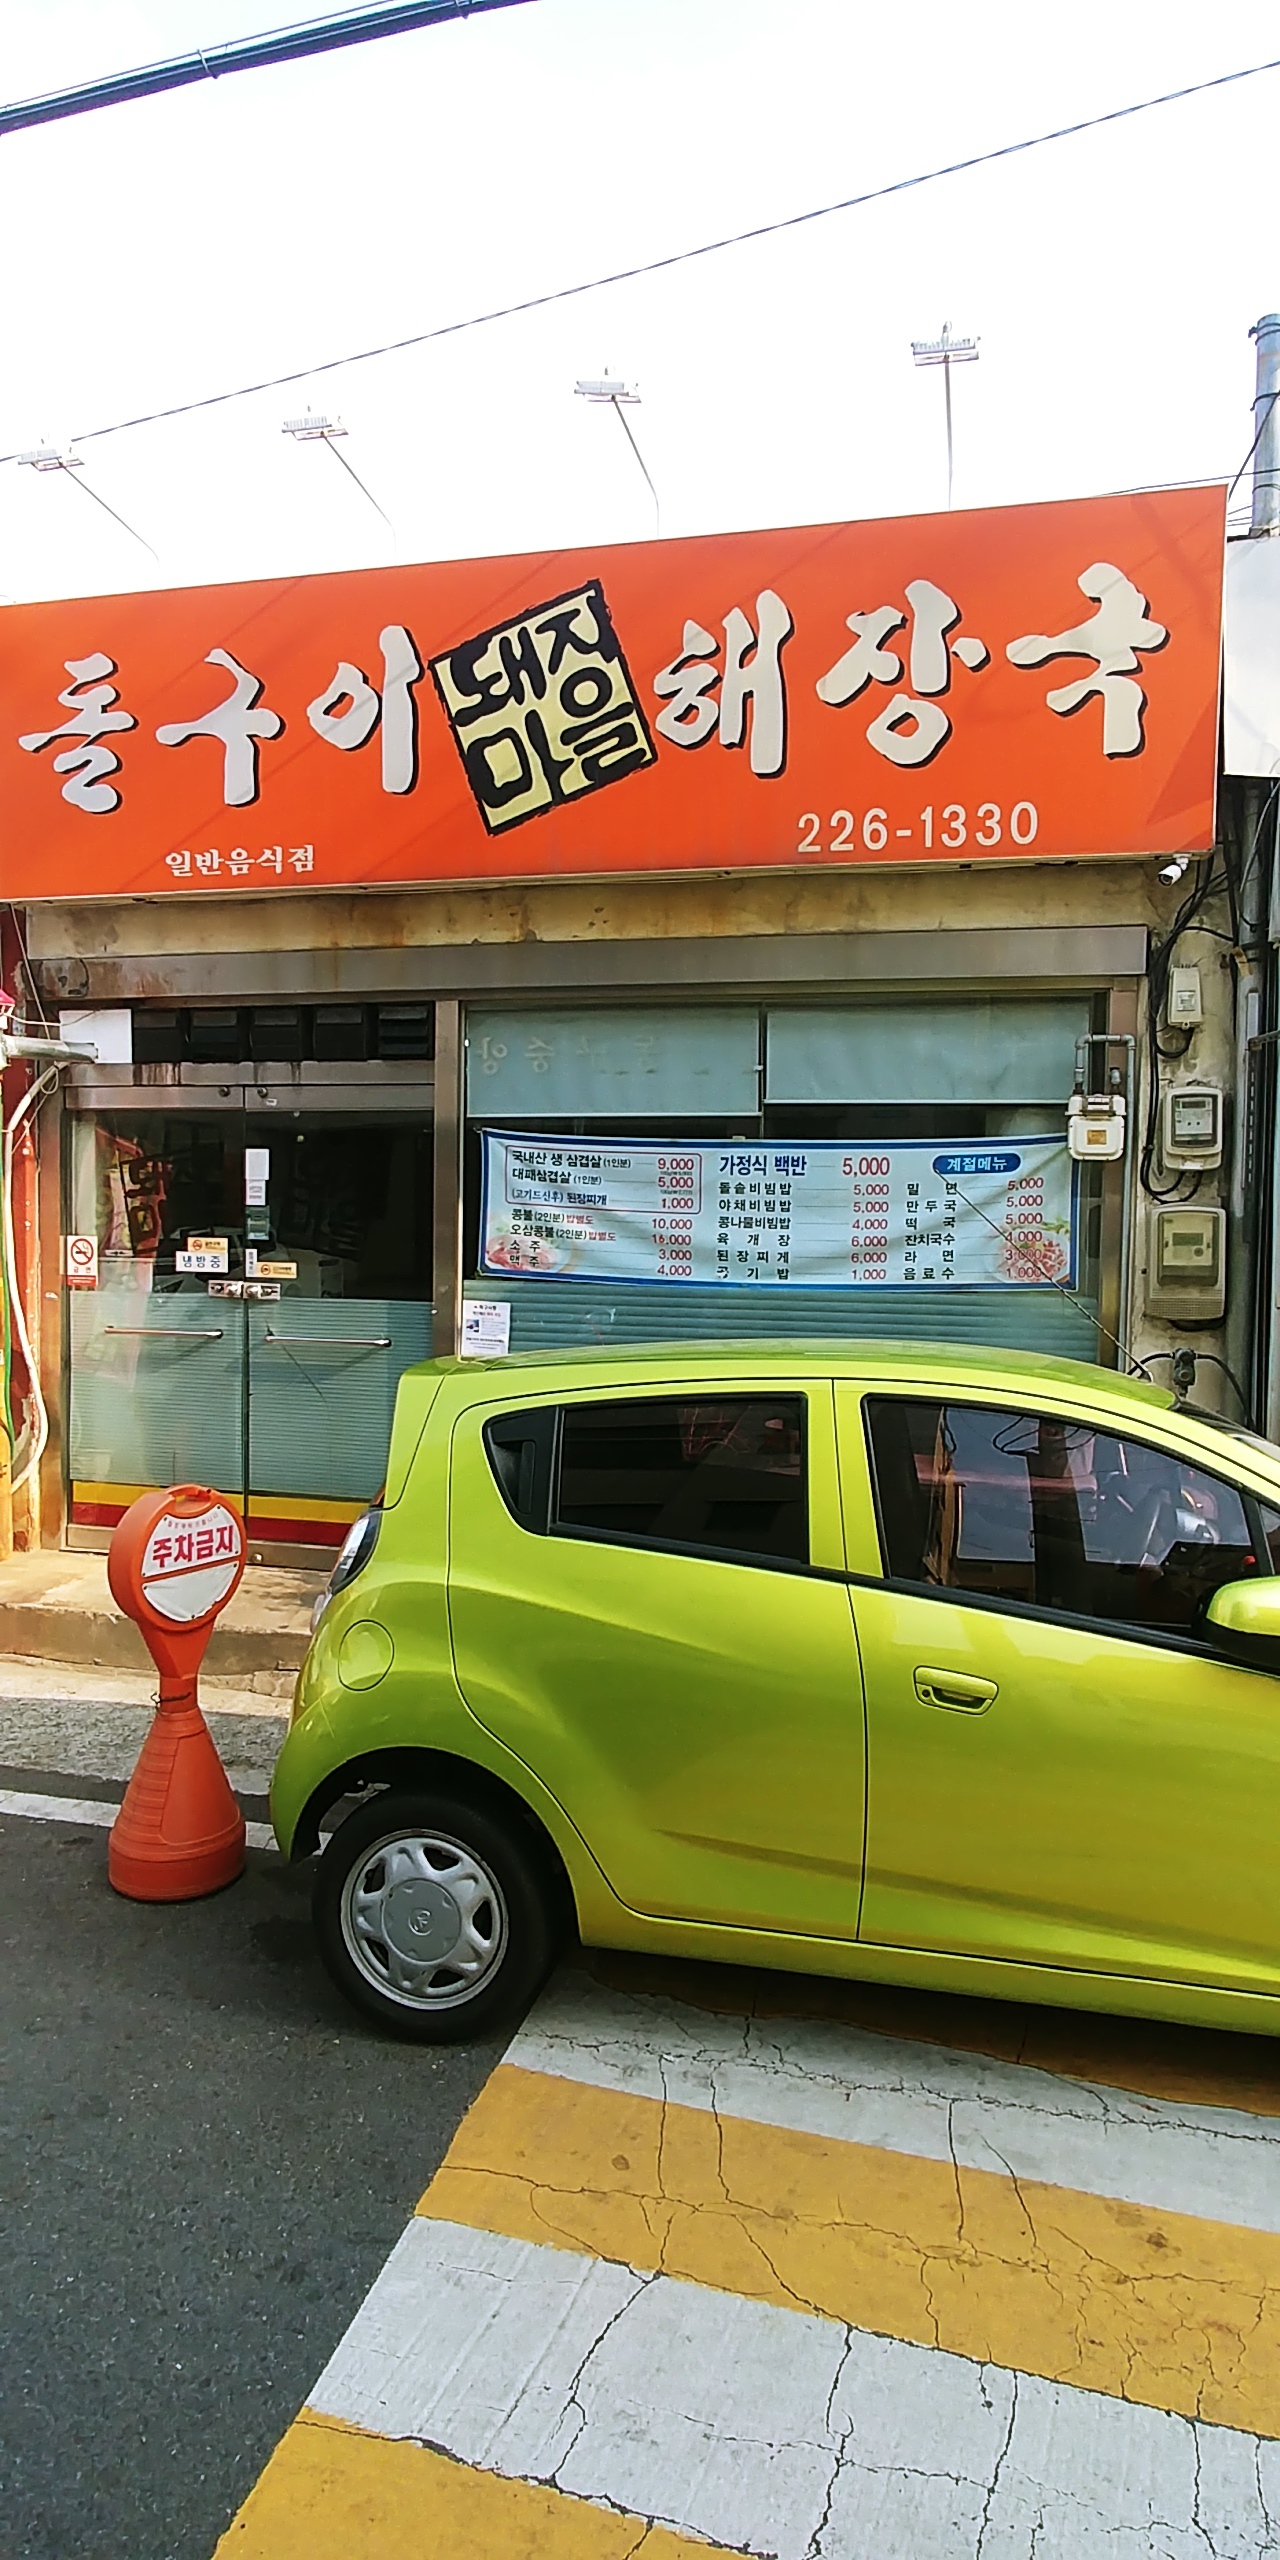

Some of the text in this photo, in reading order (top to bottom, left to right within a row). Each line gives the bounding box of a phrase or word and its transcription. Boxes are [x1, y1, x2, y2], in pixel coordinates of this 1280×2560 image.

[653, 562, 1171, 779] 해장국
[18, 624, 421, 813] 돌구이
[797, 801, 1039, 853] 226-1330
[164, 844, 315, 877] 일반음식점
[512, 1150, 694, 1172] 국내산 생 삼겹살 (1인분) 9,000
[719, 1155, 890, 1178] 가정식 백반 5,000
[946, 1157, 1008, 1172] 계절메뉴
[512, 1168, 694, 1191] 대패삼겹살 (1인분) 5,000
[1007, 1177, 1044, 1191] 5,000
[853, 1184, 890, 1197] 5,000
[512, 1188, 694, 1210] (고기드신후) 된장찌개 1,000
[718, 1199, 889, 1214] 야채비빔밥 5,000
[1006, 1195, 1043, 1208] 5,000
[511, 1208, 693, 1231] 콩불 (2인분) 밥별도 10,000
[717, 1216, 888, 1231] 콩나물비빔밥 4,000
[1005, 1212, 1043, 1225] 5,000
[510, 1224, 692, 1247] 오삼콩불 (2인분) 밥별도 16,000
[851, 1236, 888, 1248] 6,000
[905, 1232, 956, 1246] 잔치국수
[182, 1255, 221, 1269] 냉방중
[658, 1250, 692, 1262] 3,000
[851, 1252, 888, 1265] 6,000
[657, 1265, 692, 1278] 4,000
[852, 1269, 887, 1281] 1,000
[152, 1525, 234, 1568] 주차금지
